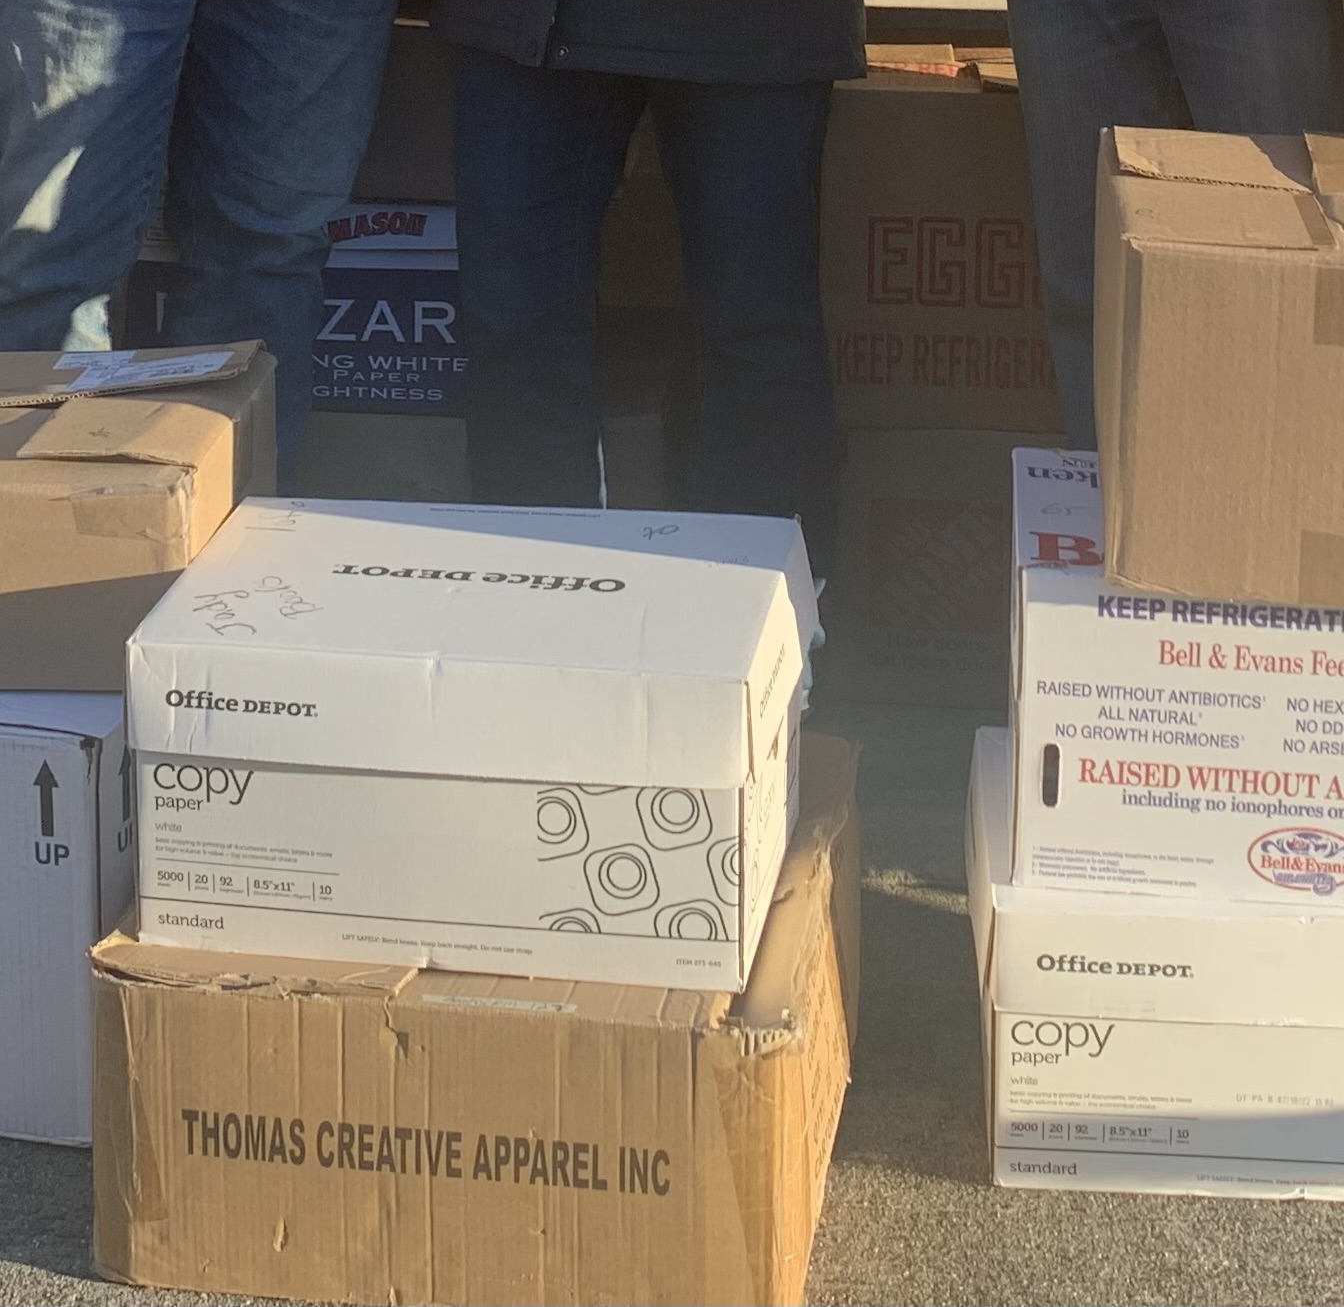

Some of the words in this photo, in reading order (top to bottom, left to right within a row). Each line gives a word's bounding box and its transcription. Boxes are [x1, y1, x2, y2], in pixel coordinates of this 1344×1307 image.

[868, 216, 1047, 310] EGG
[315, 299, 456, 343] ZAR
[368, 356, 469, 372] WHITE
[836, 333, 903, 385] KEEP
[334, 370, 420, 382] PAPER
[333, 563, 474, 583] DEPOT
[481, 569, 626, 593] Office
[1098, 595, 1166, 621] KEEP
[1158, 639, 1202, 669] Bell
[1209, 644, 1227, 670] &
[1234, 645, 1304, 676] Evans
[166, 689, 239, 712] Office
[242, 699, 317, 717] DEPOT
[1037, 680, 1092, 698] RAISED
[1096, 685, 1165, 703] WITHOUT
[1098, 706, 1124, 721] ALL
[1287, 698, 1309, 712] NO
[1056, 723, 1076, 738] NO
[1081, 726, 1149, 743] GROWTH
[1296, 719, 1318, 733] NO
[1283, 738, 1305, 753] NO
[153, 763, 254, 805] copy
[1078, 757, 1181, 789] RAISED
[1187, 765, 1320, 799] WITHOUT
[154, 795, 203, 812] paper
[1122, 789, 1203, 813] including
[1205, 797, 1226, 812] no
[1230, 796, 1324, 819] ionophores
[155, 822, 182, 833] white
[34, 842, 70, 867] UP
[157, 871, 184, 881] 5000
[195, 874, 208, 884] 20
[220, 876, 233, 886] 92
[319, 885, 332, 895] 10
[158, 912, 224, 929] standard
[1037, 954, 1112, 974] Office
[1116, 962, 1192, 978] DEPOT
[1011, 1020, 1115, 1058] copy
[1011, 1051, 1062, 1067] paper
[1011, 1075, 1038, 1086] white
[1011, 1122, 1038, 1133] 5000
[1049, 1123, 1063, 1134] 20
[1074, 1125, 1089, 1134] 92
[1176, 1129, 1190, 1139] 10
[181, 1108, 307, 1166] THOMAS
[316, 1120, 462, 1180] CREATIVE
[472, 1134, 608, 1193] APPAREL
[618, 1148, 671, 1198] INC
[1010, 1161, 1077, 1175] standard
